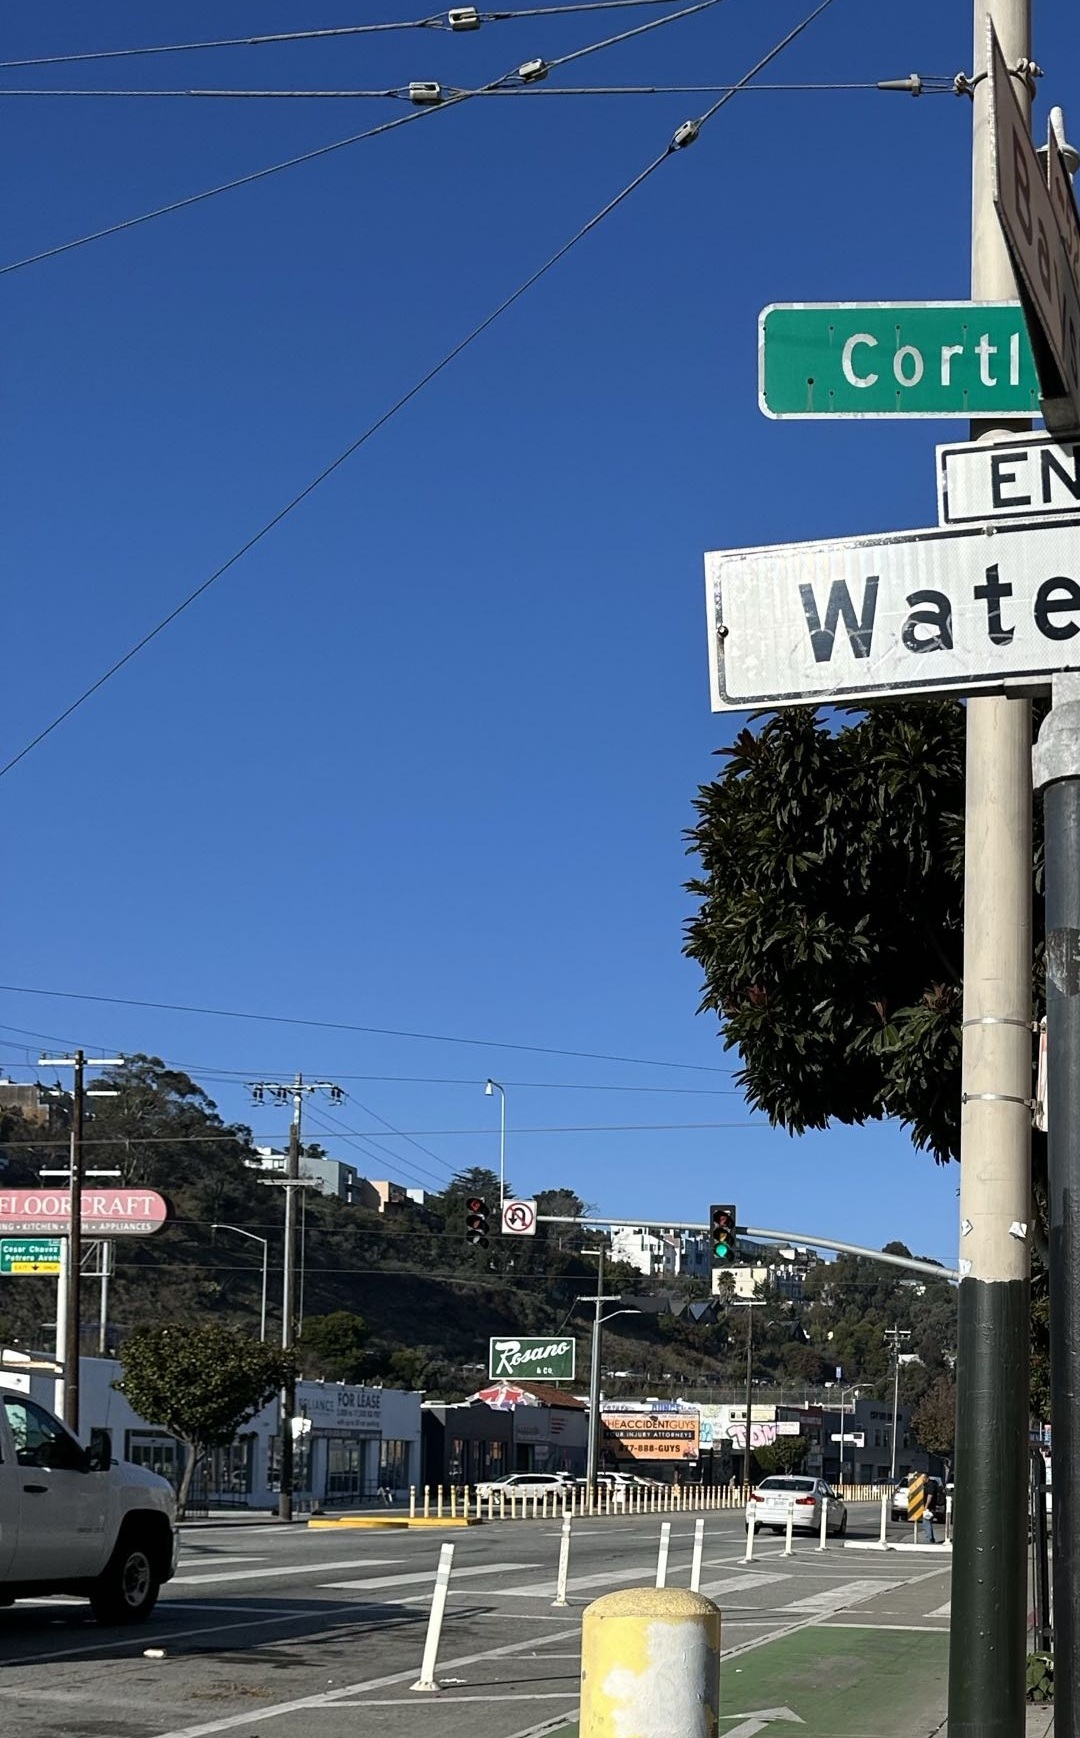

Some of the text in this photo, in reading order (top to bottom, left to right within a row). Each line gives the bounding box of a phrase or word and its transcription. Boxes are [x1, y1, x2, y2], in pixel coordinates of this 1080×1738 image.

[0, 1196, 154, 1216] FLOORCRAFT
[22, 1223, 59, 1231] KITCHEN
[99, 1223, 152, 1231] APPLIANCES
[495, 1341, 571, 1375] Rosano
[337, 1392, 381, 1409] FOR LEASE
